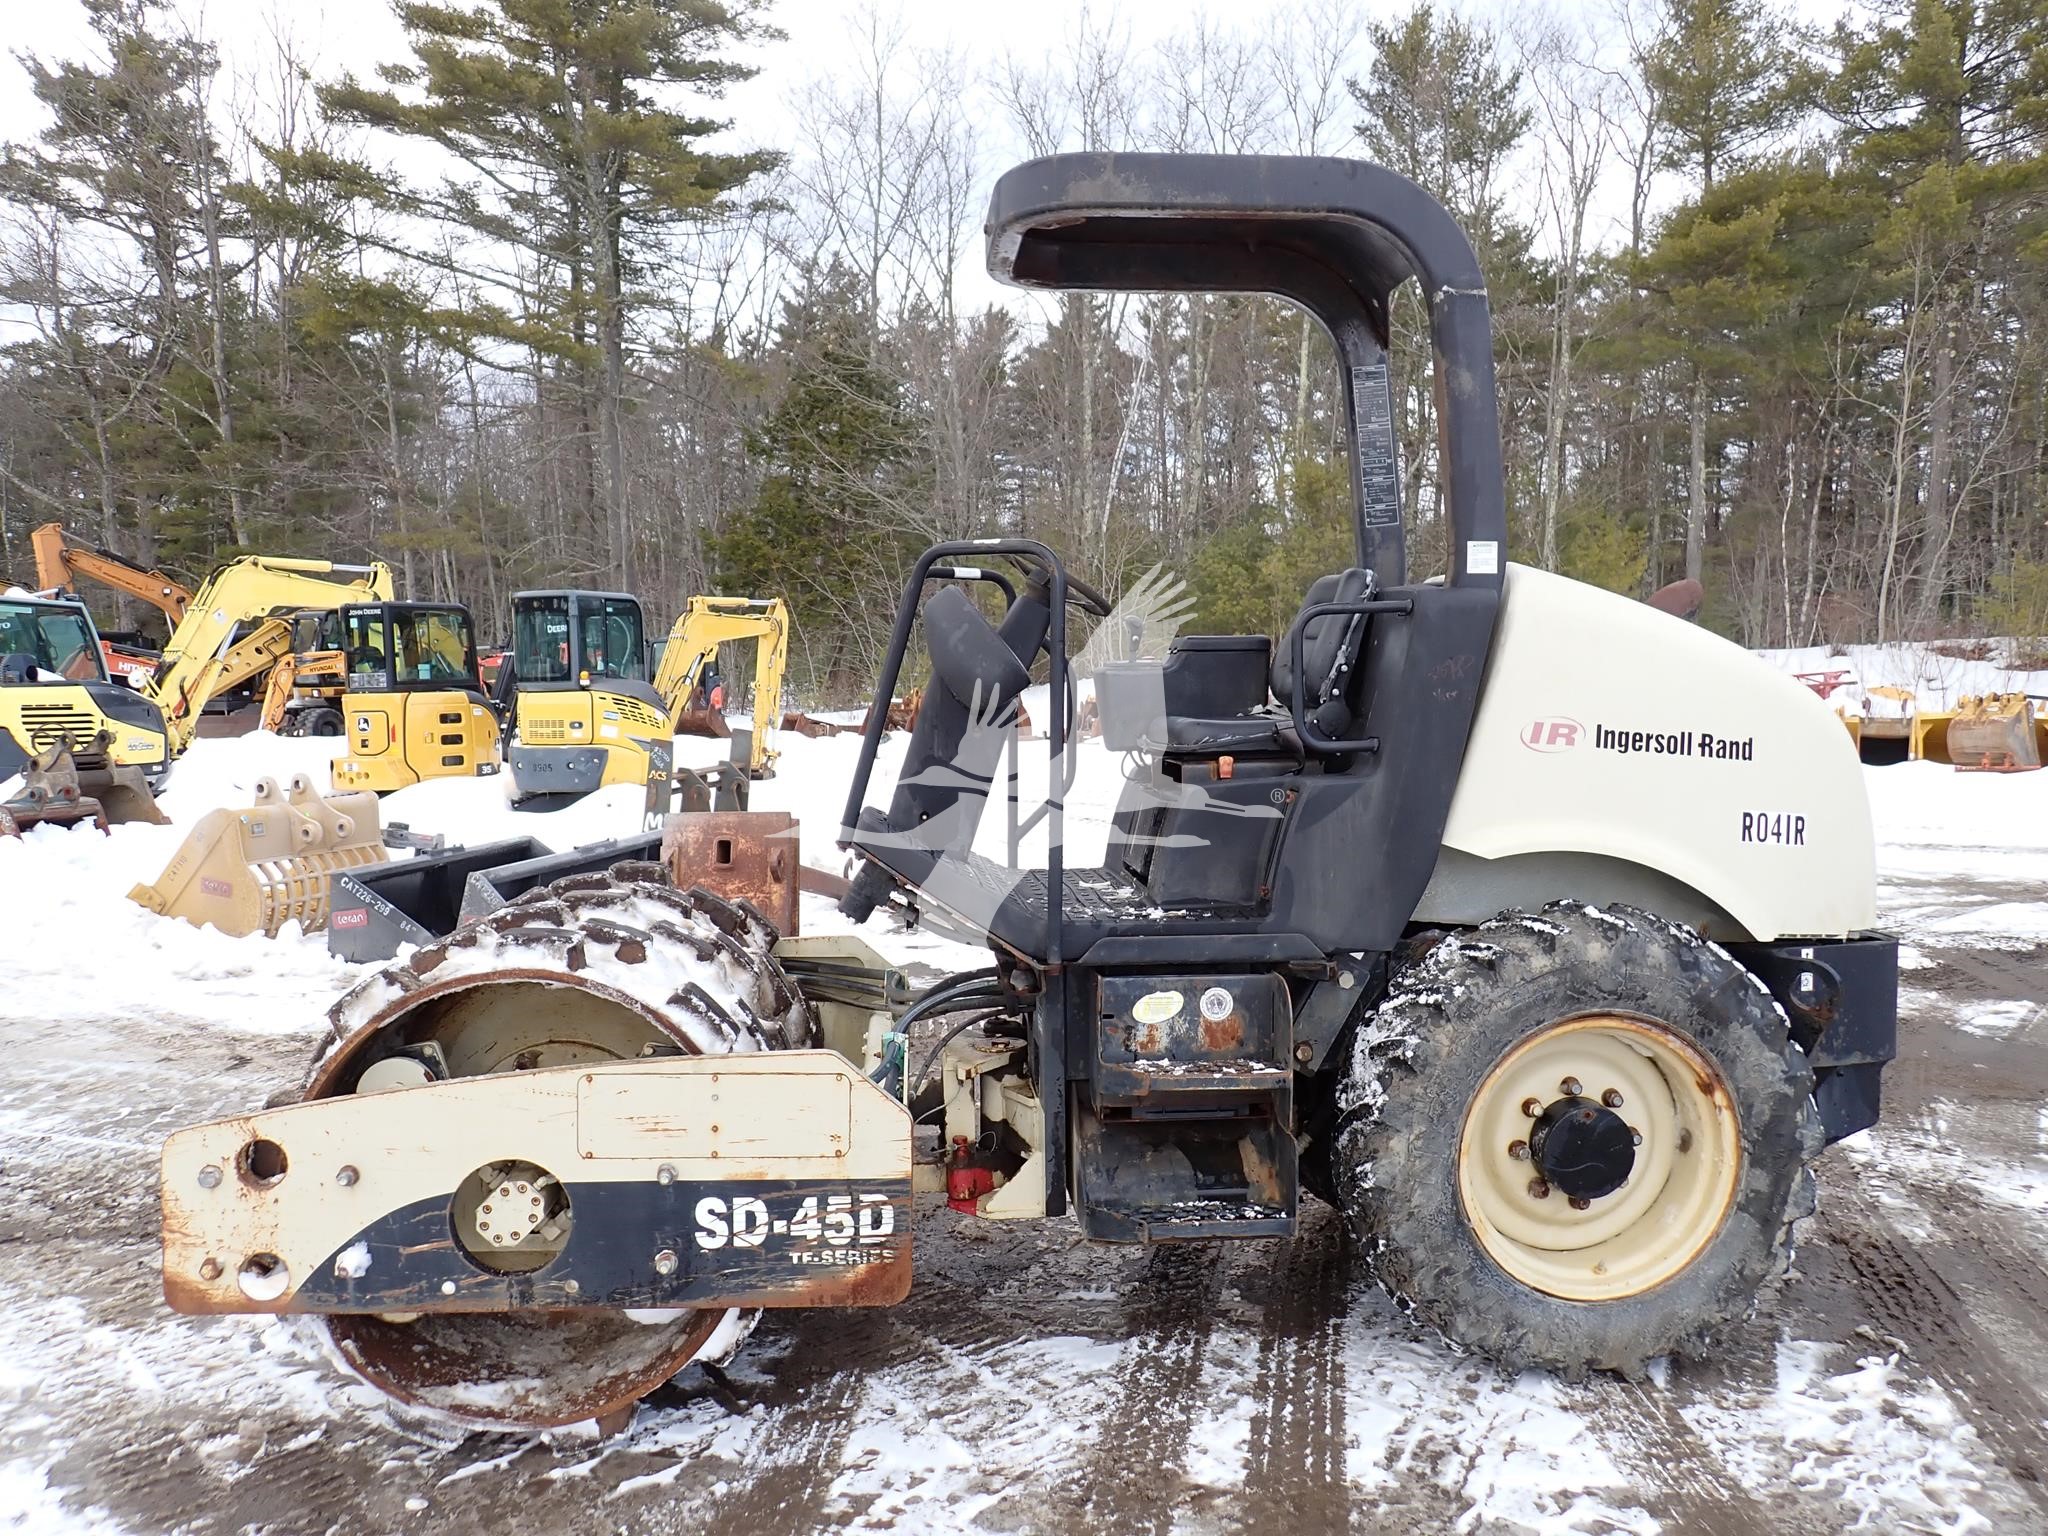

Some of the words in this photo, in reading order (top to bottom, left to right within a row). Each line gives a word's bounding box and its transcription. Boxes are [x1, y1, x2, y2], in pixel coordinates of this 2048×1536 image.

[309, 663, 334, 673] HYUNDAI
[1528, 721, 1579, 747] IR
[1595, 723, 1693, 756] Ingersoll
[649, 769, 667, 781] ACS
[340, 876, 391, 917] CAT226-299
[694, 1193, 895, 1250] SD-45D
